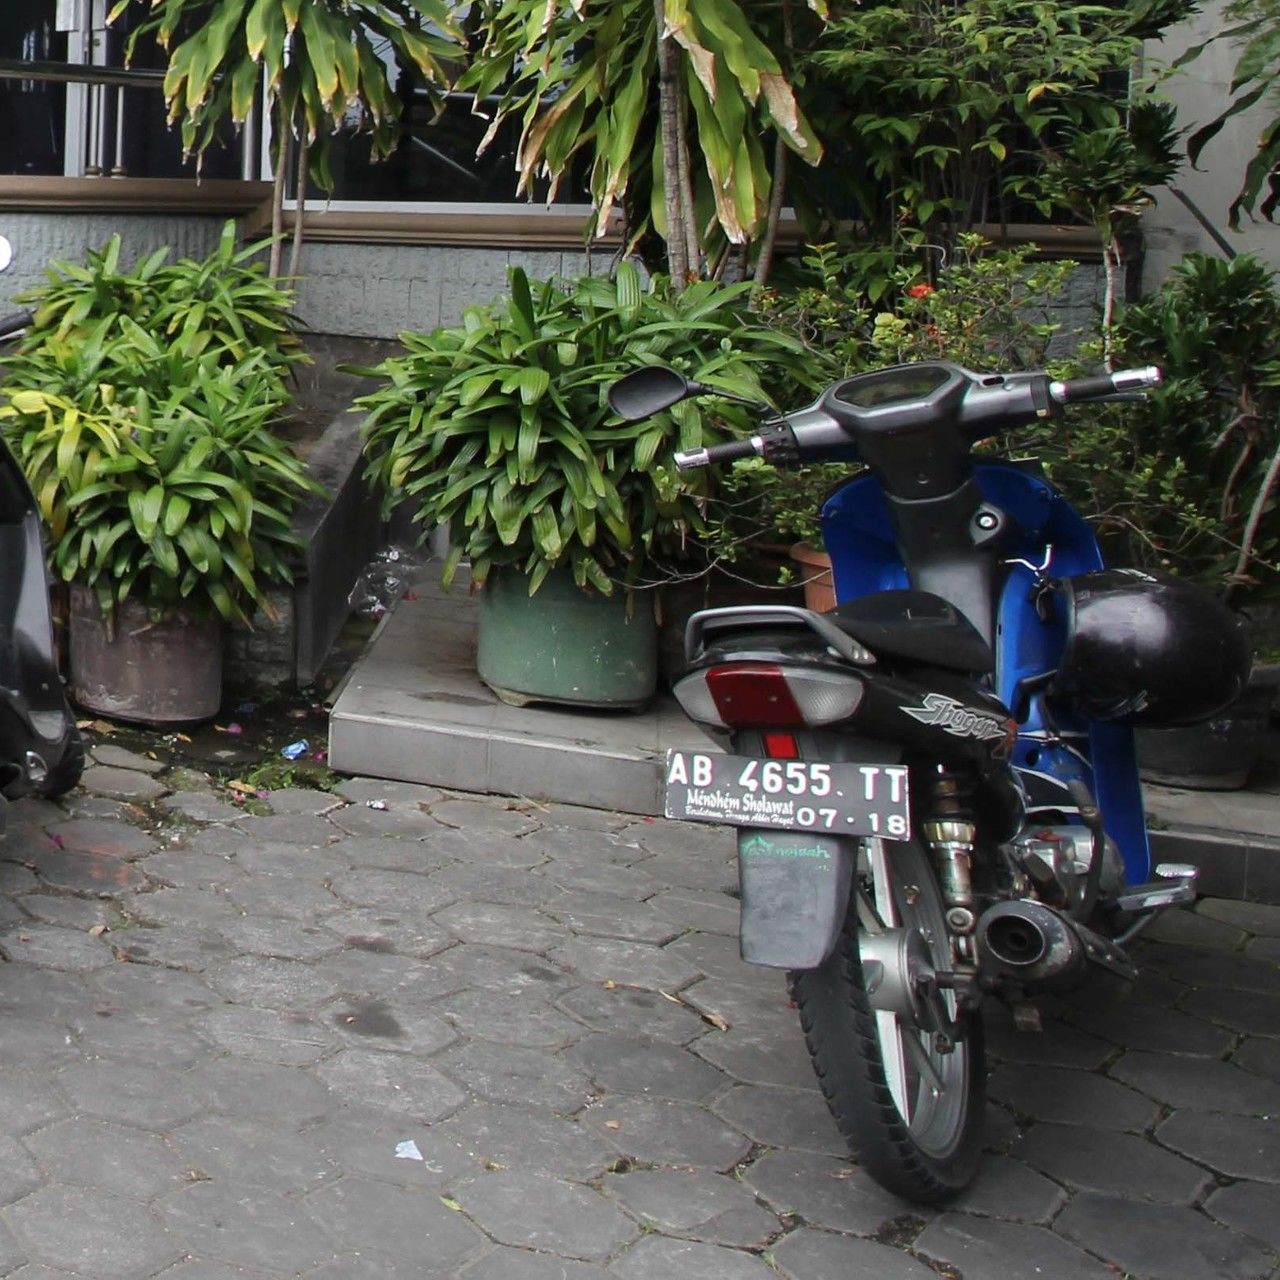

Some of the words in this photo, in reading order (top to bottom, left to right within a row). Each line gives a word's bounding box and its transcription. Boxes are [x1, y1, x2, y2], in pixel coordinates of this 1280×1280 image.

[898, 692, 1008, 740] Shogun
[668, 752, 713, 787] AB
[738, 760, 832, 797] 4655
[859, 766, 906, 803] TT
[742, 793, 794, 815] Sholawat
